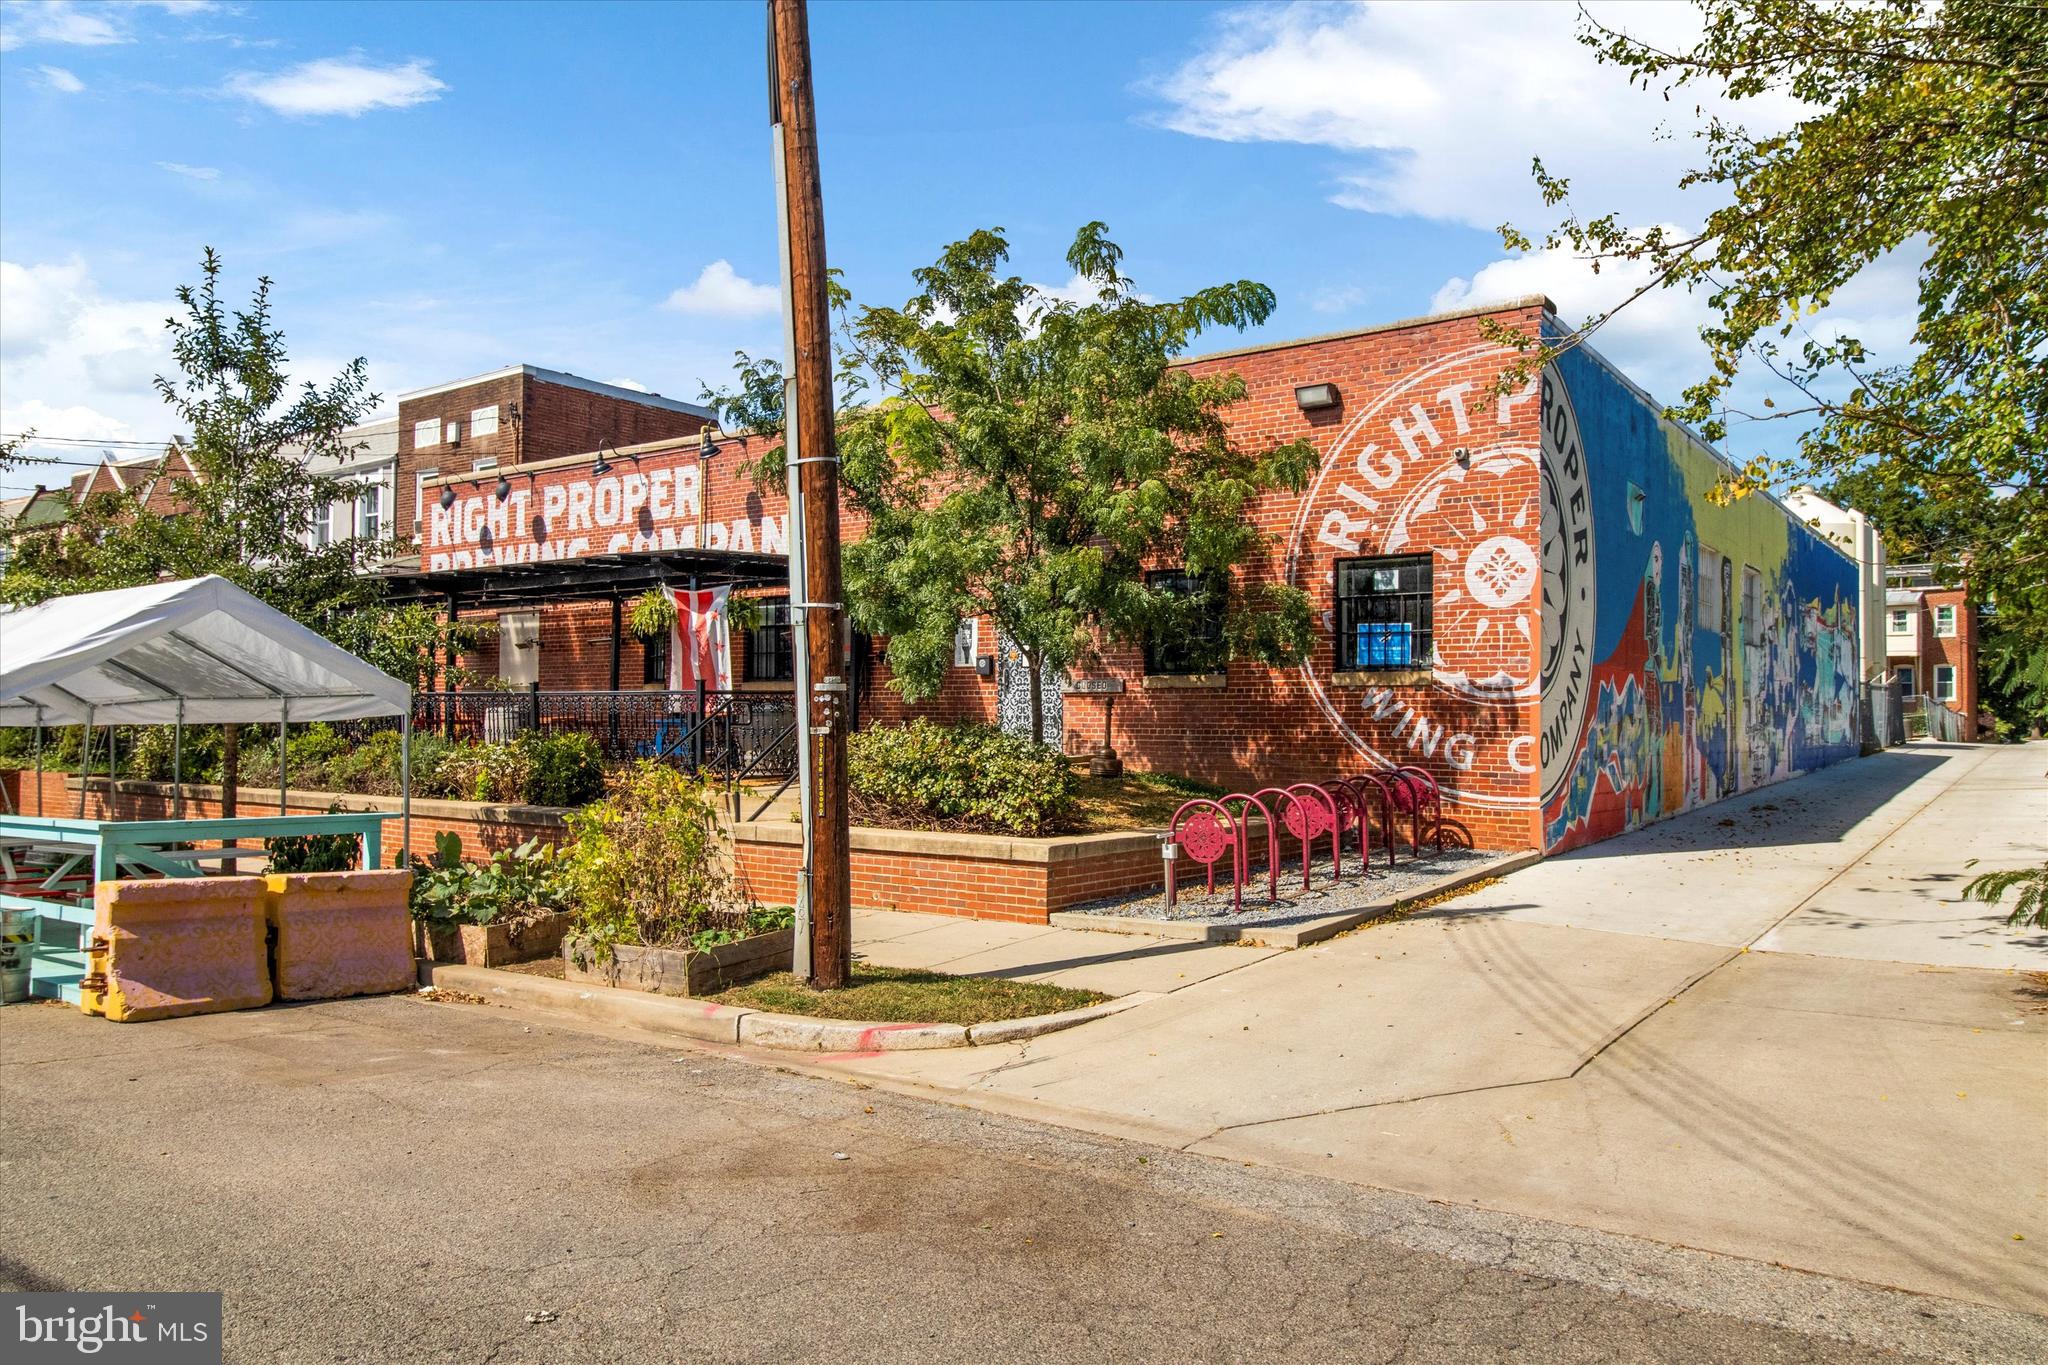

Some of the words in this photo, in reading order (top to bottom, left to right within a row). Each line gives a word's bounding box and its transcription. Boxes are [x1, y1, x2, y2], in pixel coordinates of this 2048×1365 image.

[430, 488, 531, 547] RIGHT
[543, 464, 701, 533] PROPER
[1316, 381, 1473, 554] RIGHT
